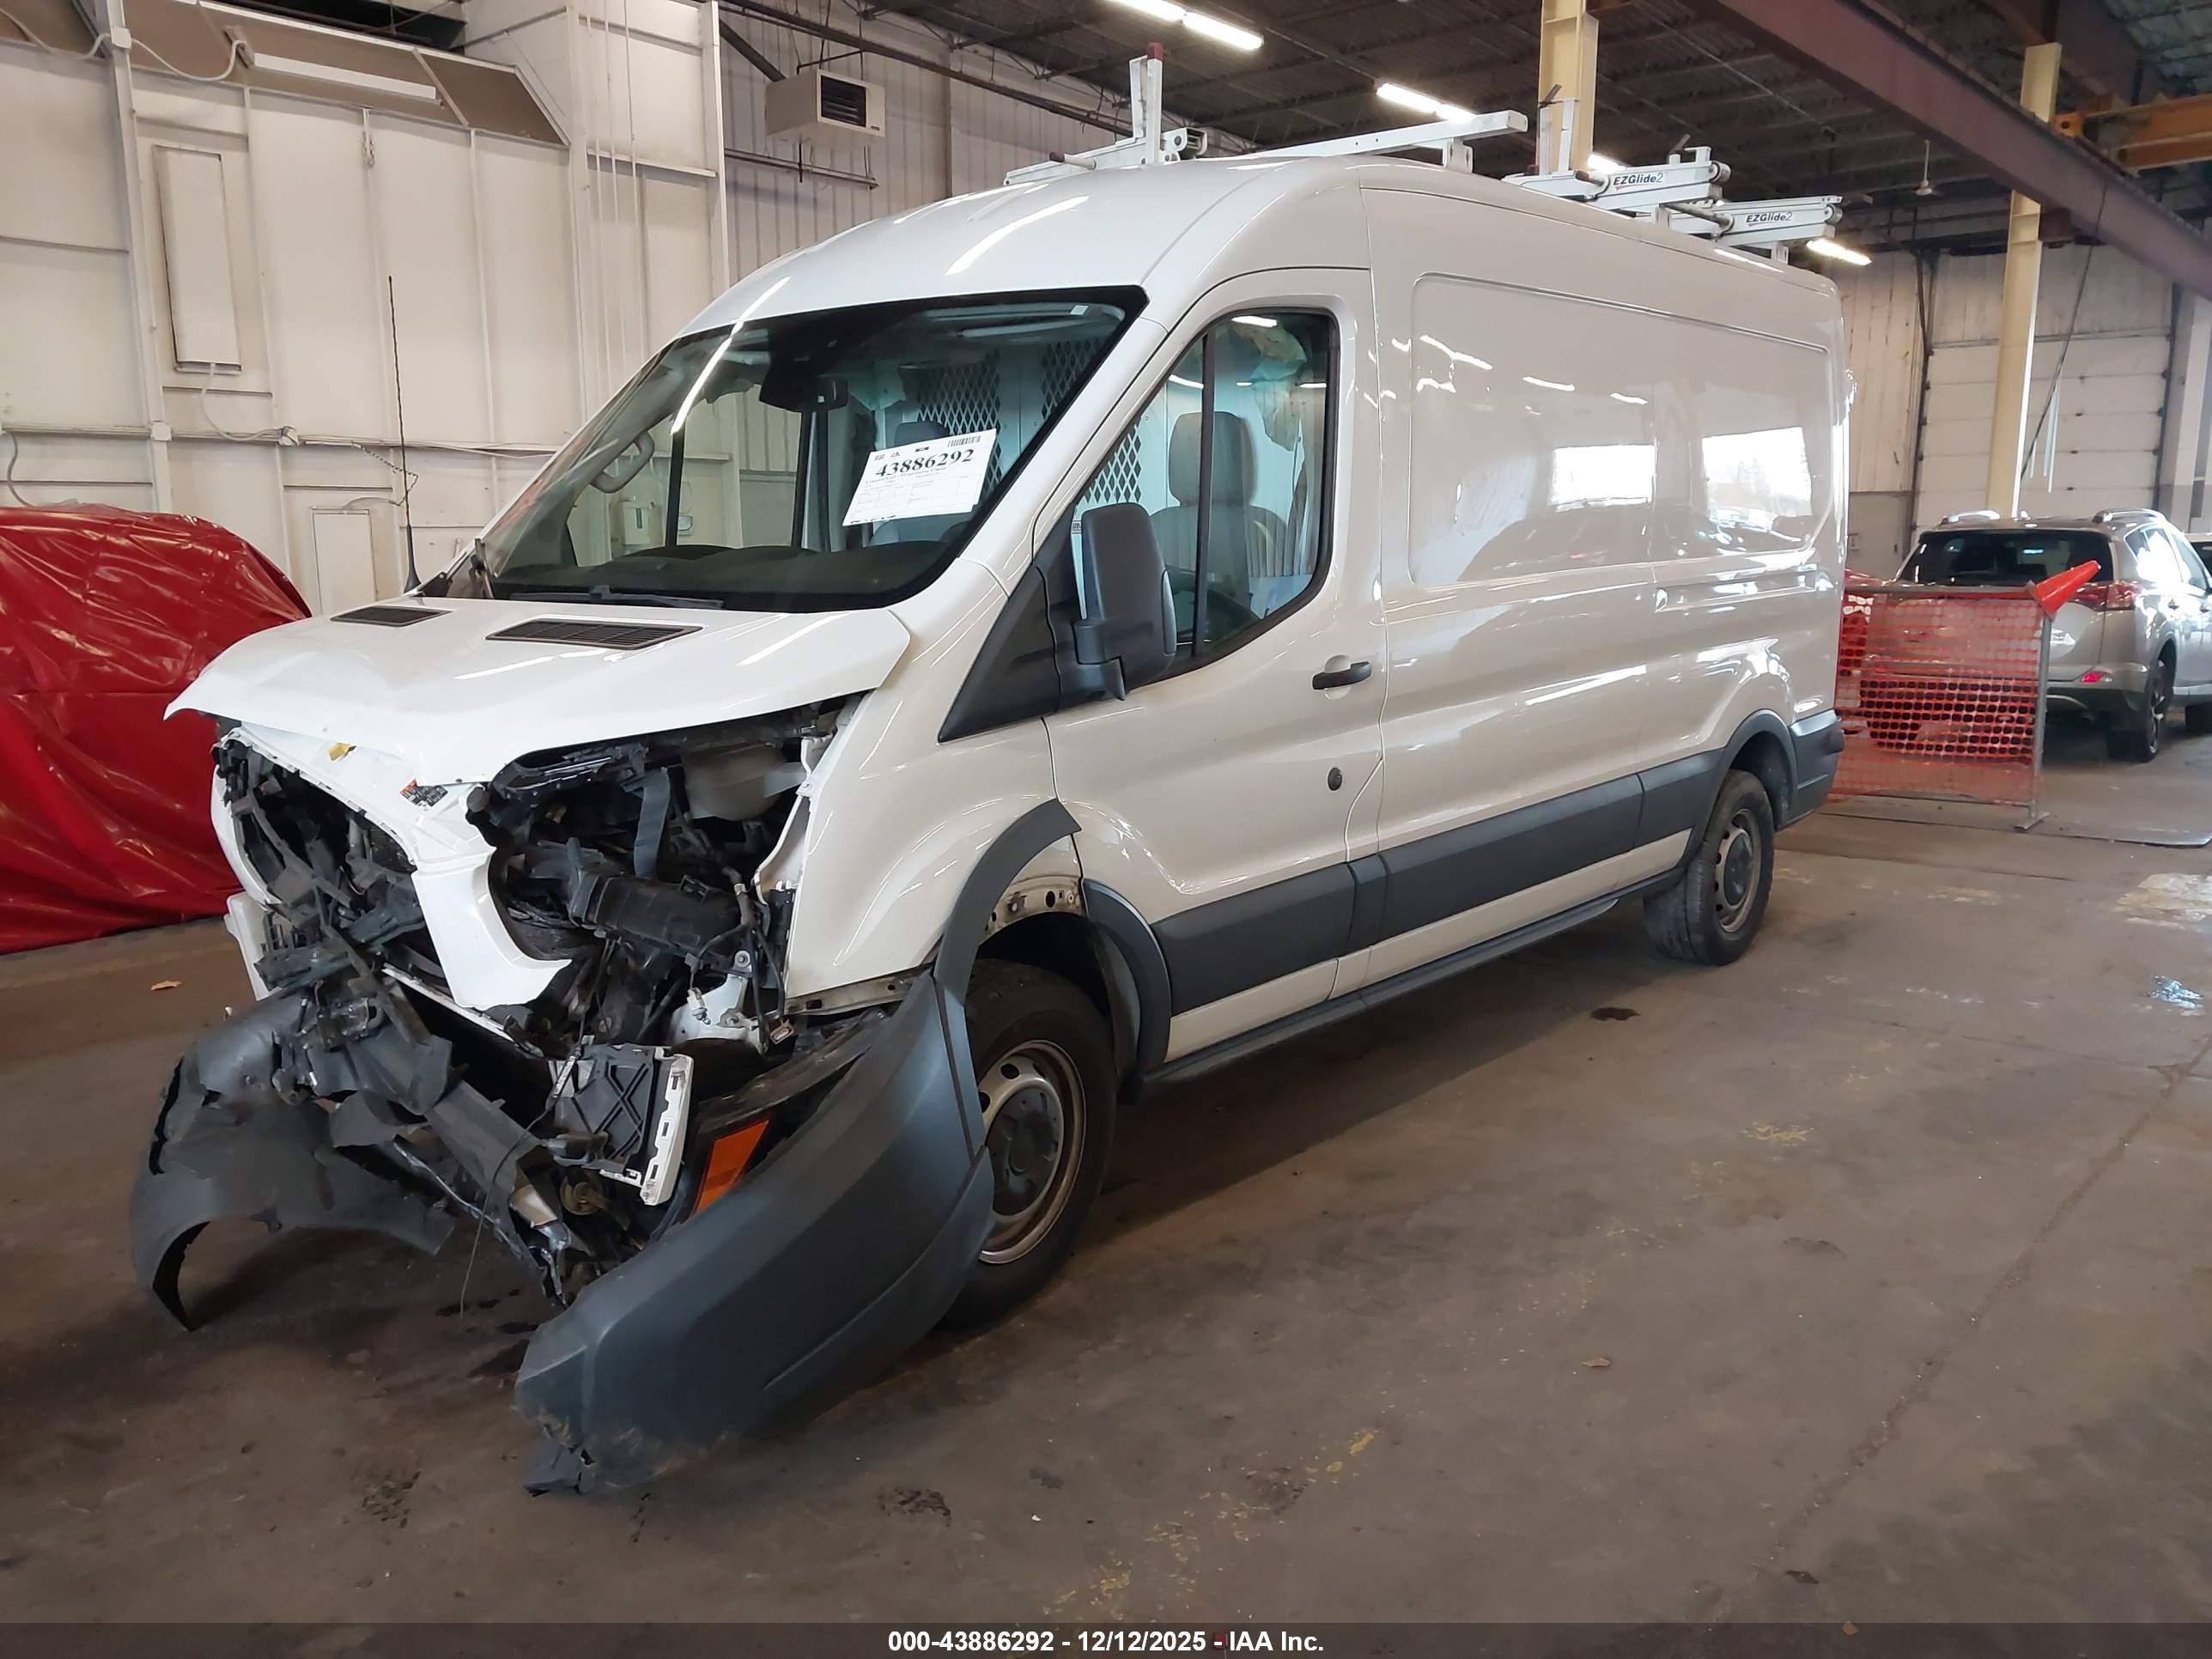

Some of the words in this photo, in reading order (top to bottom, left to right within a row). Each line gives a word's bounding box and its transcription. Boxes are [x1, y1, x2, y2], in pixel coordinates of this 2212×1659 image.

[1613, 172, 1664, 185] EZGlide2
[1745, 211, 1794, 223] EZGlide2
[875, 448, 975, 477] 43886292
